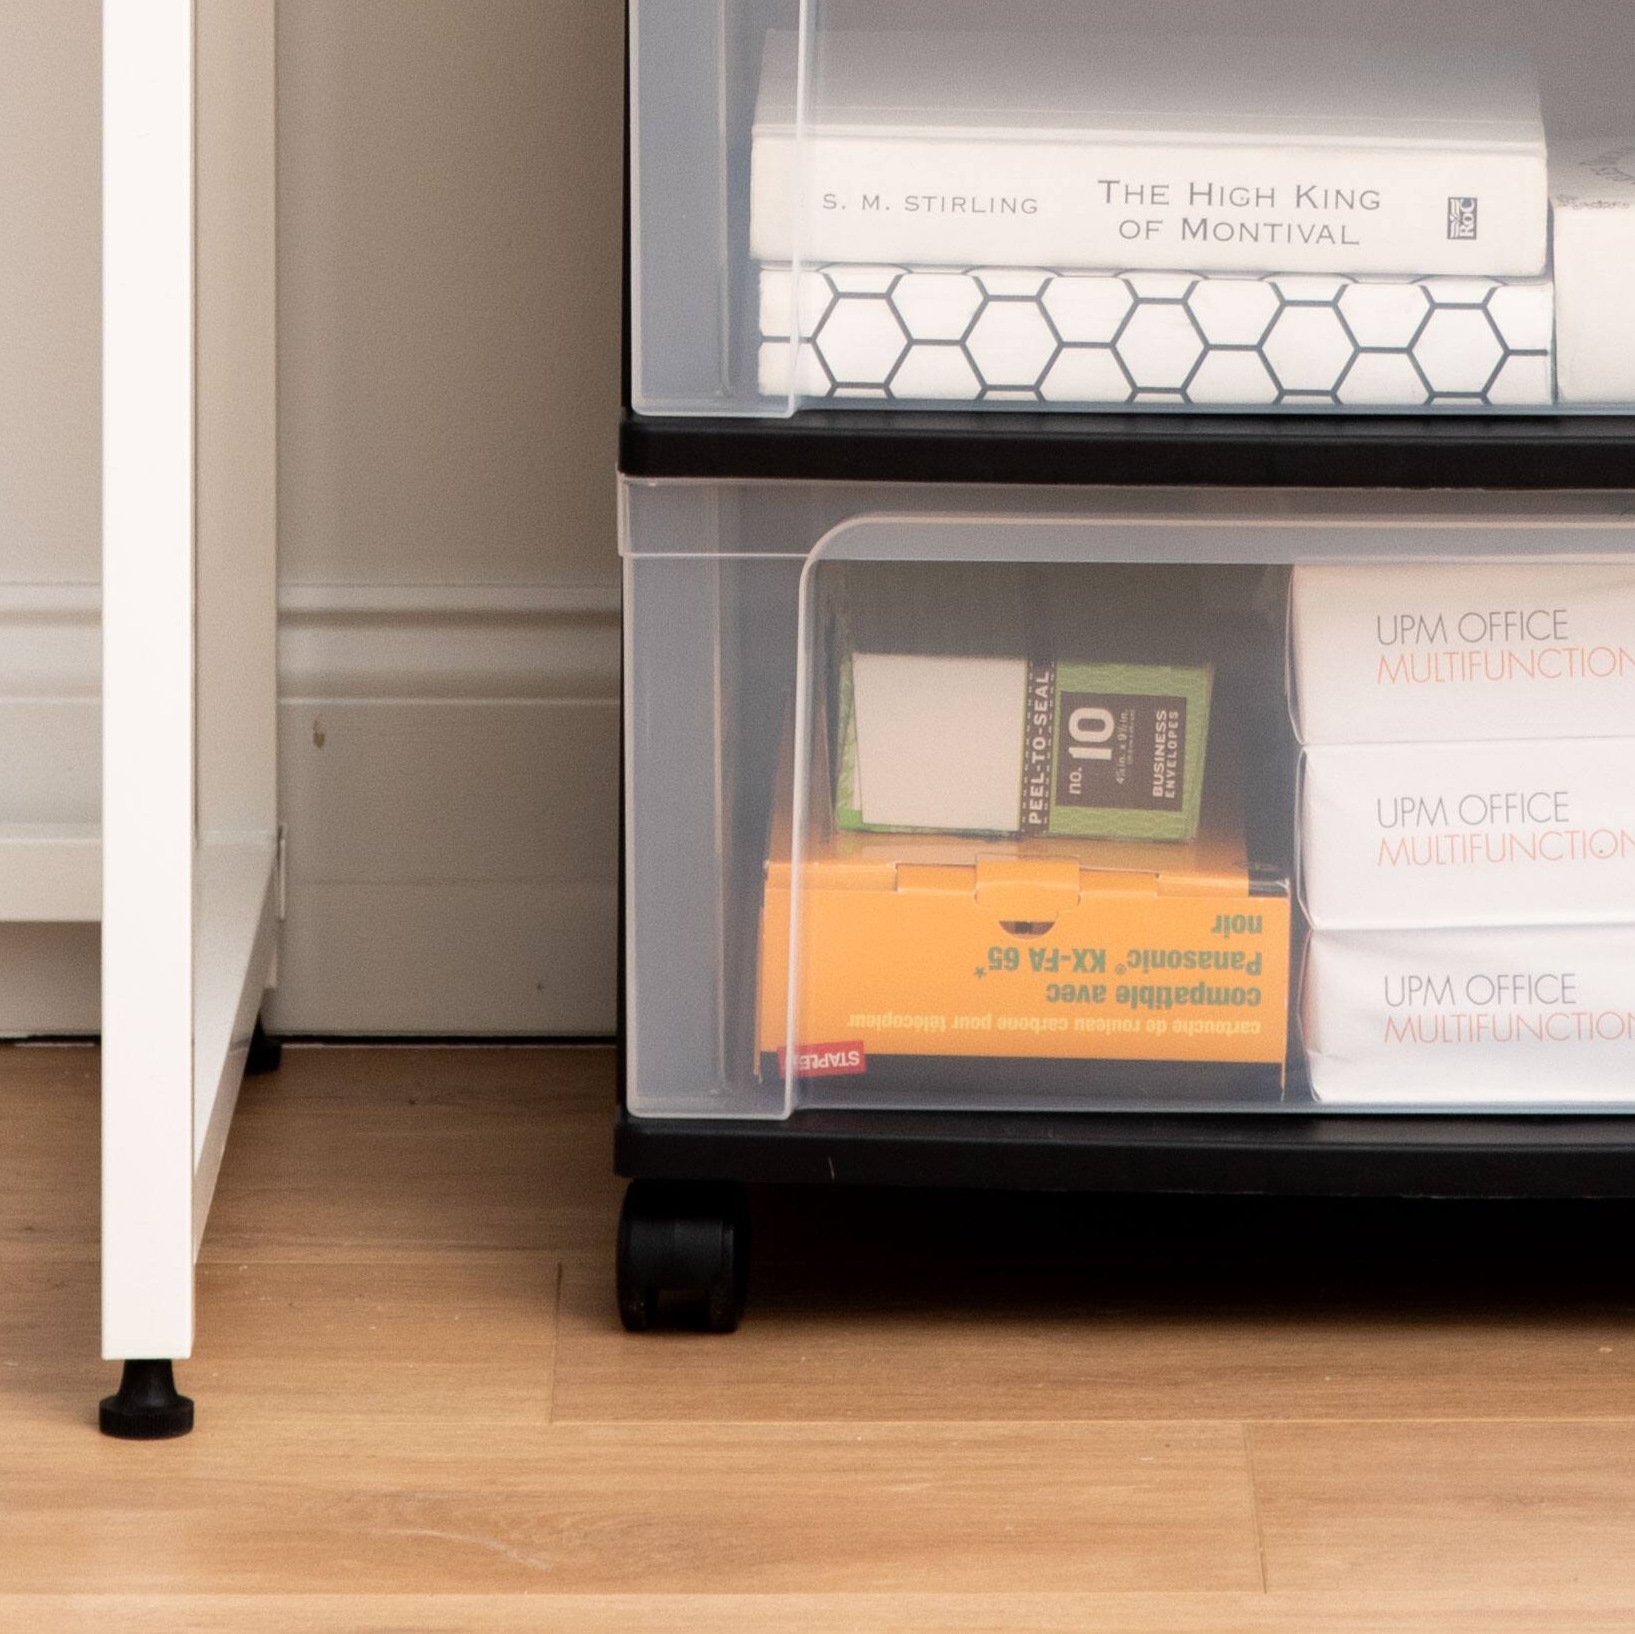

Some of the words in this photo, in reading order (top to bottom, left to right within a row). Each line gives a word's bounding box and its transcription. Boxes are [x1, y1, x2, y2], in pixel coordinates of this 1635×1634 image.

[822, 192, 846, 210] S.
[862, 194, 890, 211] M.
[904, 195, 1038, 215] STIRLING
[1097, 179, 1170, 206] THE
[1189, 181, 1275, 208] HIGH
[1295, 184, 1380, 211] KING
[1118, 219, 1163, 240] OF
[1181, 217, 1360, 245] MONTIVAL
[1377, 613, 1449, 645] UPM
[1457, 609, 1569, 644] OFFICE
[1028, 670, 1050, 825] PEEL-TO-SEAL
[1067, 706, 1116, 762] 10
[1152, 709, 1168, 798] BUSINESS
[1165, 710, 1180, 799] ENVELOPES
[1068, 766, 1084, 796] no.
[1377, 795, 1449, 829] UPM
[1457, 791, 1570, 827] OFFICE
[1211, 913, 1263, 939] noir
[1028, 946, 1107, 974] KX-FA
[1045, 982, 1107, 1005] avec
[1115, 982, 1262, 1011] compatible
[1384, 974, 1456, 1008] UPM
[1465, 972, 1577, 1006] OFFICE
[846, 1012, 946, 1032] télécopieur
[951, 1013, 991, 1031] pour
[997, 1015, 1068, 1034] carbone
[1073, 1015, 1143, 1035] rouleau
[1145, 1017, 1167, 1035] de
[1172, 1016, 1262, 1036] cartouche
[789, 1050, 862, 1072] STAPLE
